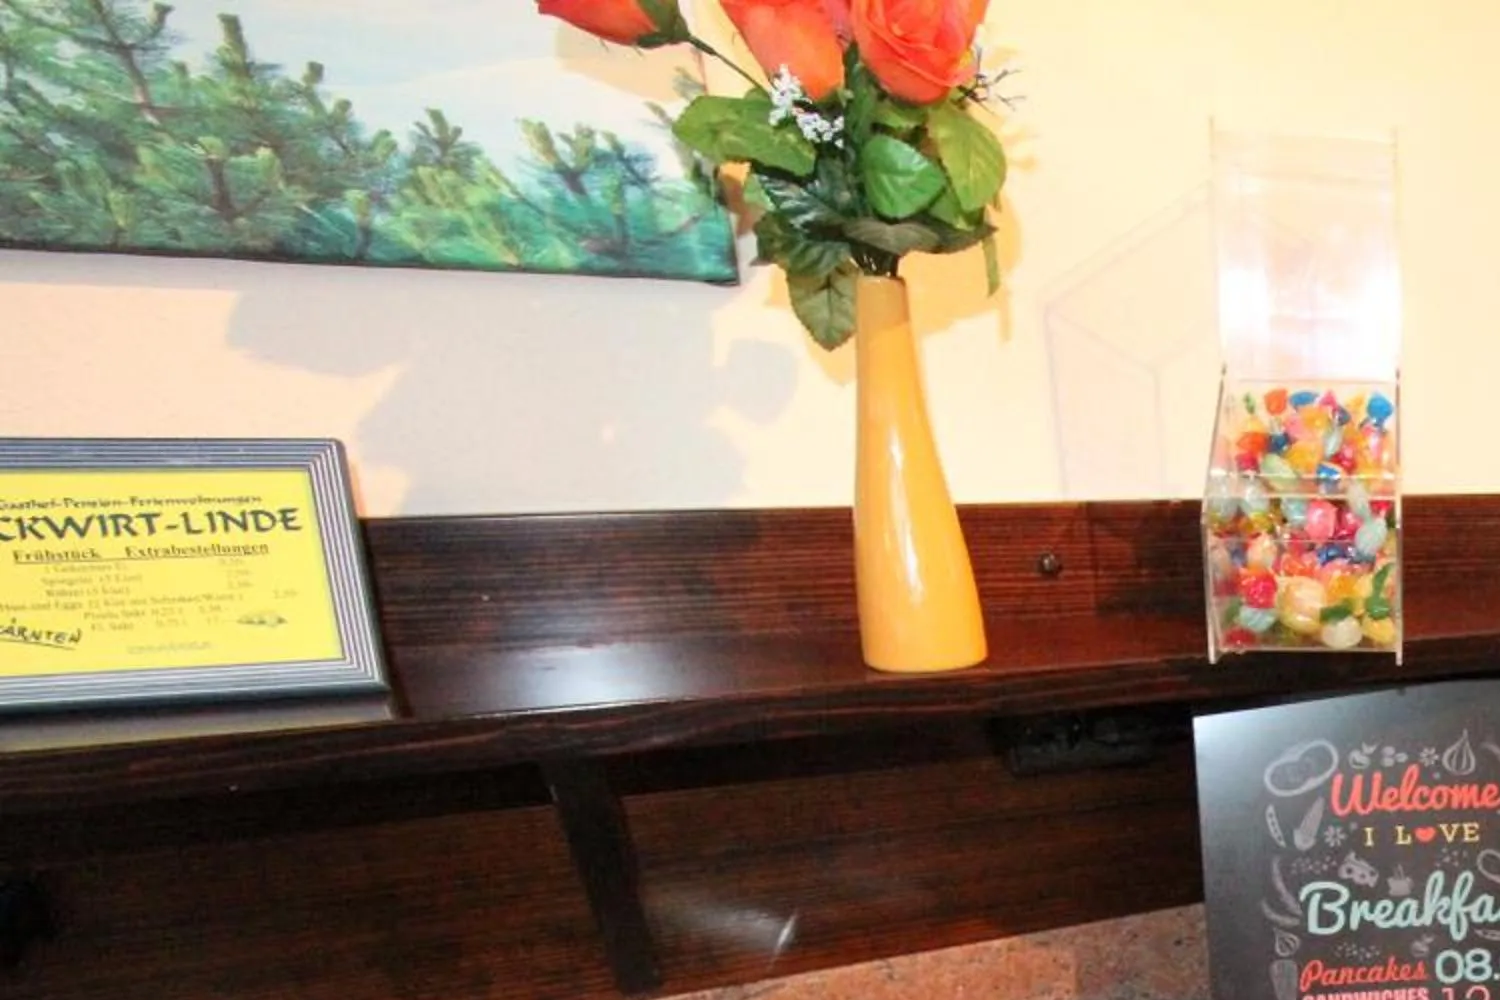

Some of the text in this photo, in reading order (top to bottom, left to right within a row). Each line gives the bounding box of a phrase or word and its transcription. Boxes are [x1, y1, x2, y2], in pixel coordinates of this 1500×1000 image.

[124, 543, 269, 559] Extrabestellungen
[0, 616, 83, 645] ÄRNTEN
[1363, 822, 1480, 847] I LVE
[1300, 955, 1430, 993] Pancakes
